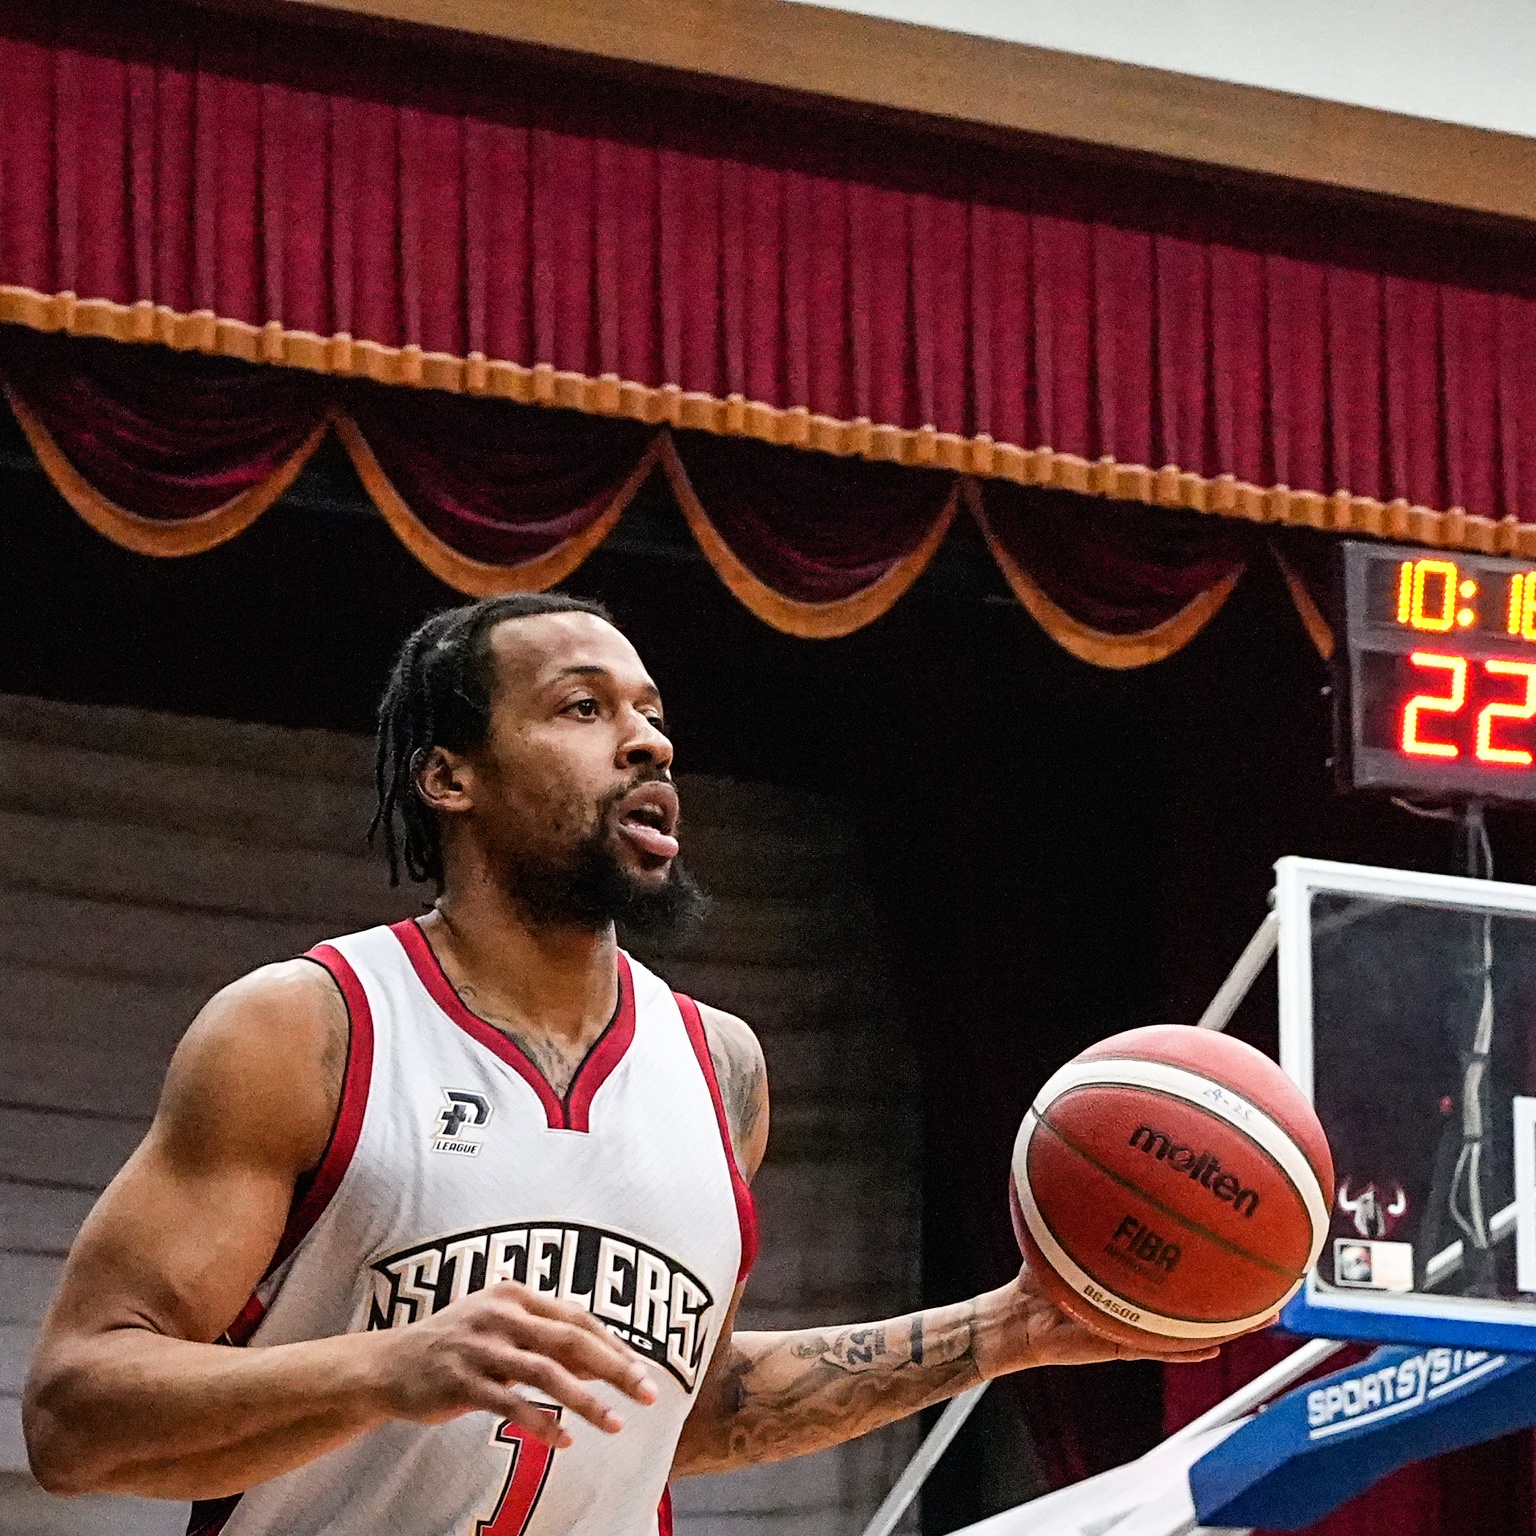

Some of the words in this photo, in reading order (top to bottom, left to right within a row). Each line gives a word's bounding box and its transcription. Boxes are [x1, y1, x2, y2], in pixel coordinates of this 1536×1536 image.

[435, 1140, 479, 1155] LEAGUE
[1128, 1123, 1260, 1218] molten
[1113, 1213, 1183, 1274] FIBA
[384, 1227, 710, 1387] STEELERS
[1307, 1348, 1490, 1428] SPORTSYST
